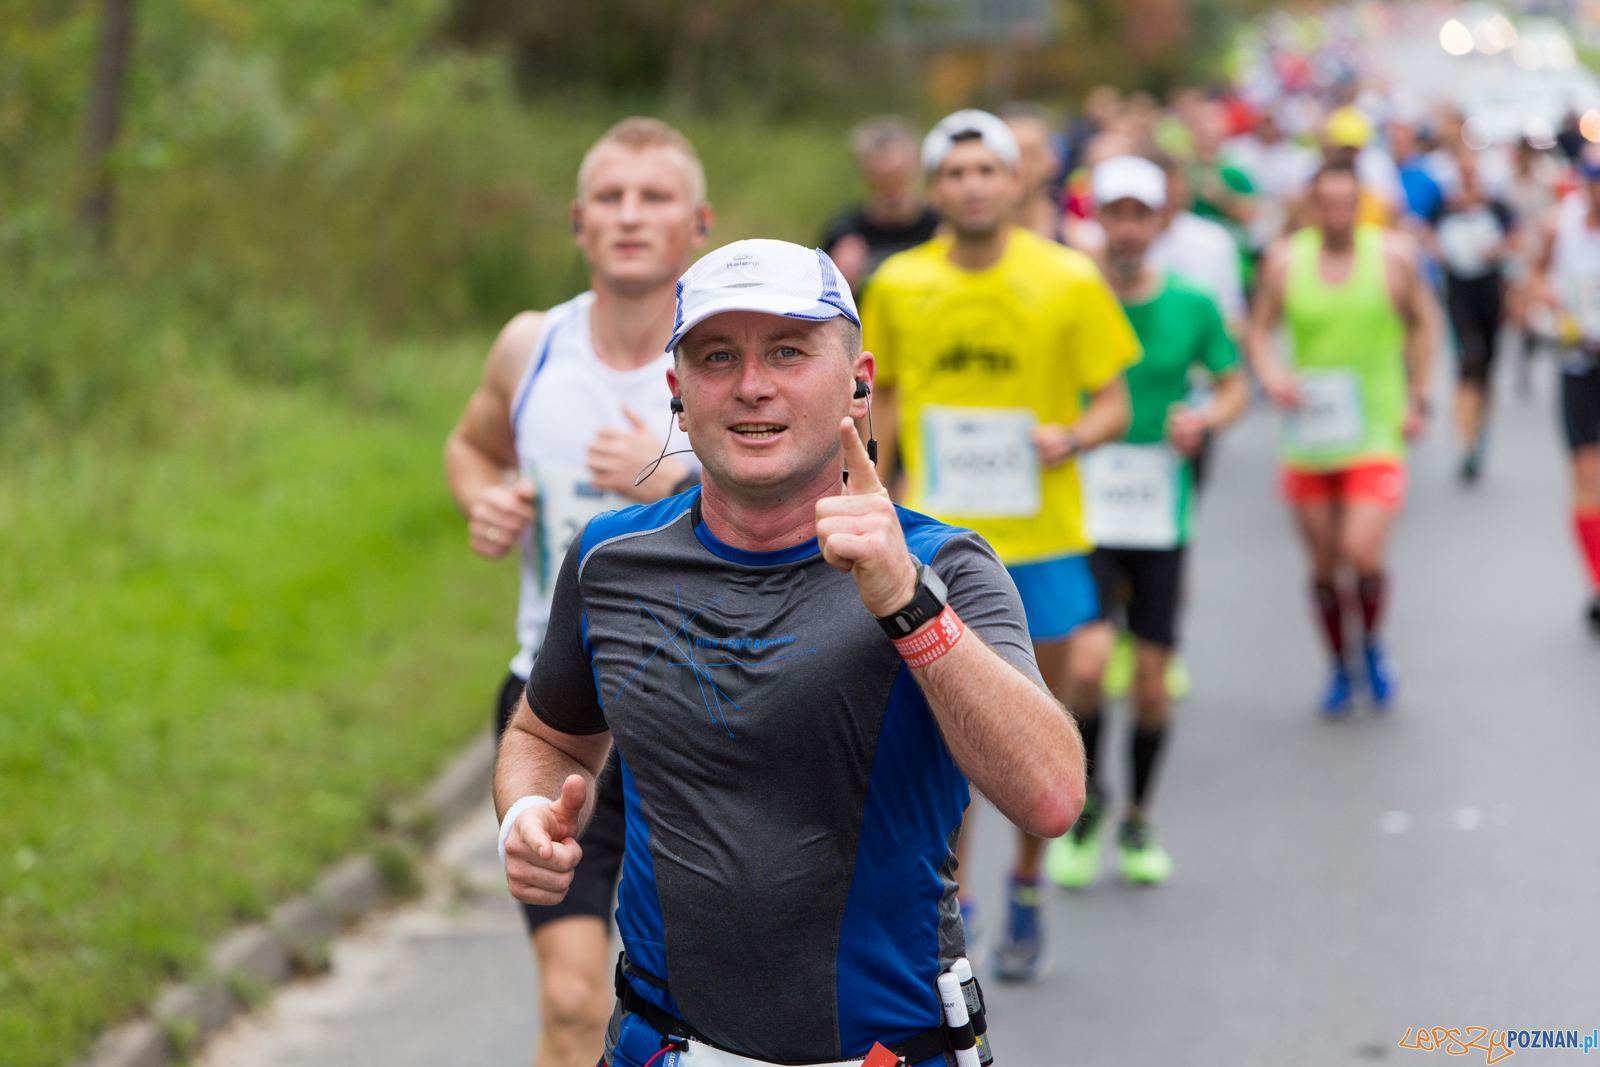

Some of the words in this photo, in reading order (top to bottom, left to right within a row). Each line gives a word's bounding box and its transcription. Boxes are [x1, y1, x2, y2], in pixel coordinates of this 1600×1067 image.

[726, 261, 759, 269] Kalenji
[944, 611, 961, 637] FINISH
[696, 637, 719, 648] HIGH
[721, 633, 796, 649] PERFORMANCE
